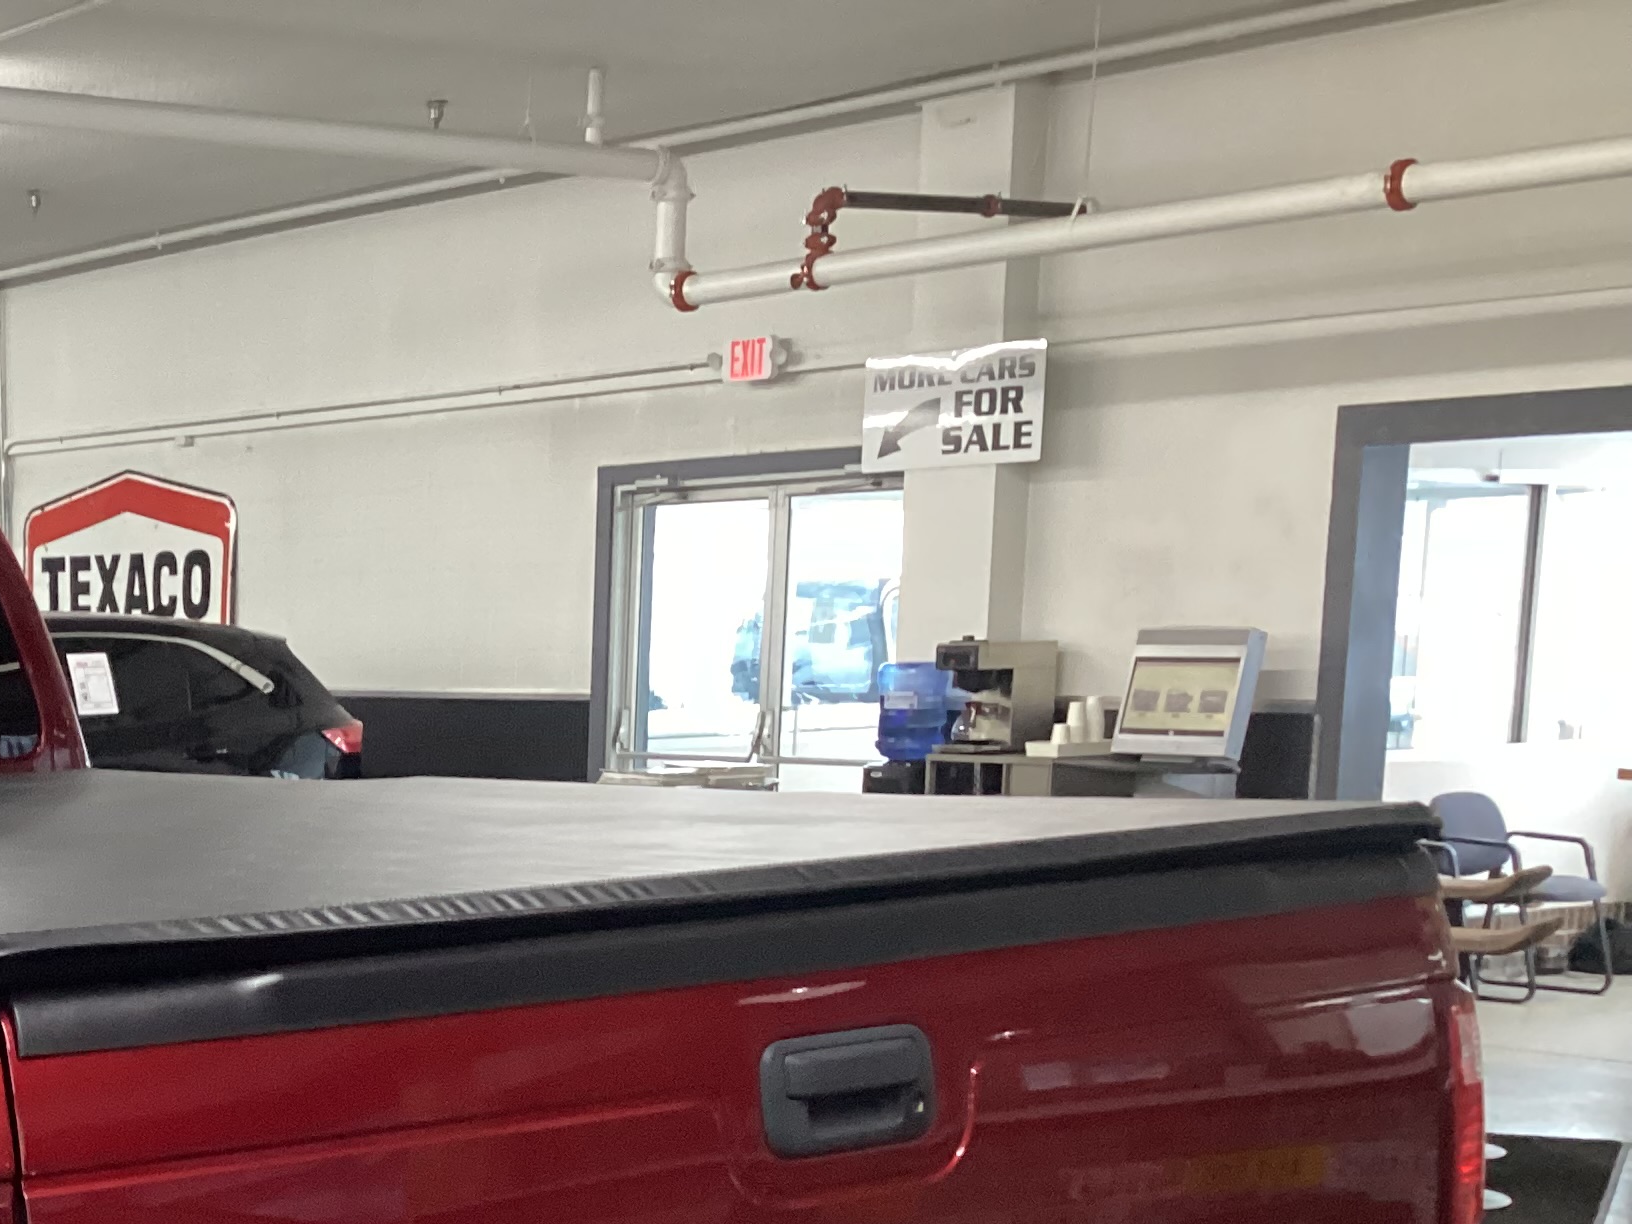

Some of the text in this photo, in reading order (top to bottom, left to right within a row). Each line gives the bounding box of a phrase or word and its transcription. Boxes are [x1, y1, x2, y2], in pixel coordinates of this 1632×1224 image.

[730, 337, 767, 379] EXIT
[954, 385, 1024, 418] FOR
[941, 420, 1033, 455] SALE
[41, 549, 212, 620] TEXACO
